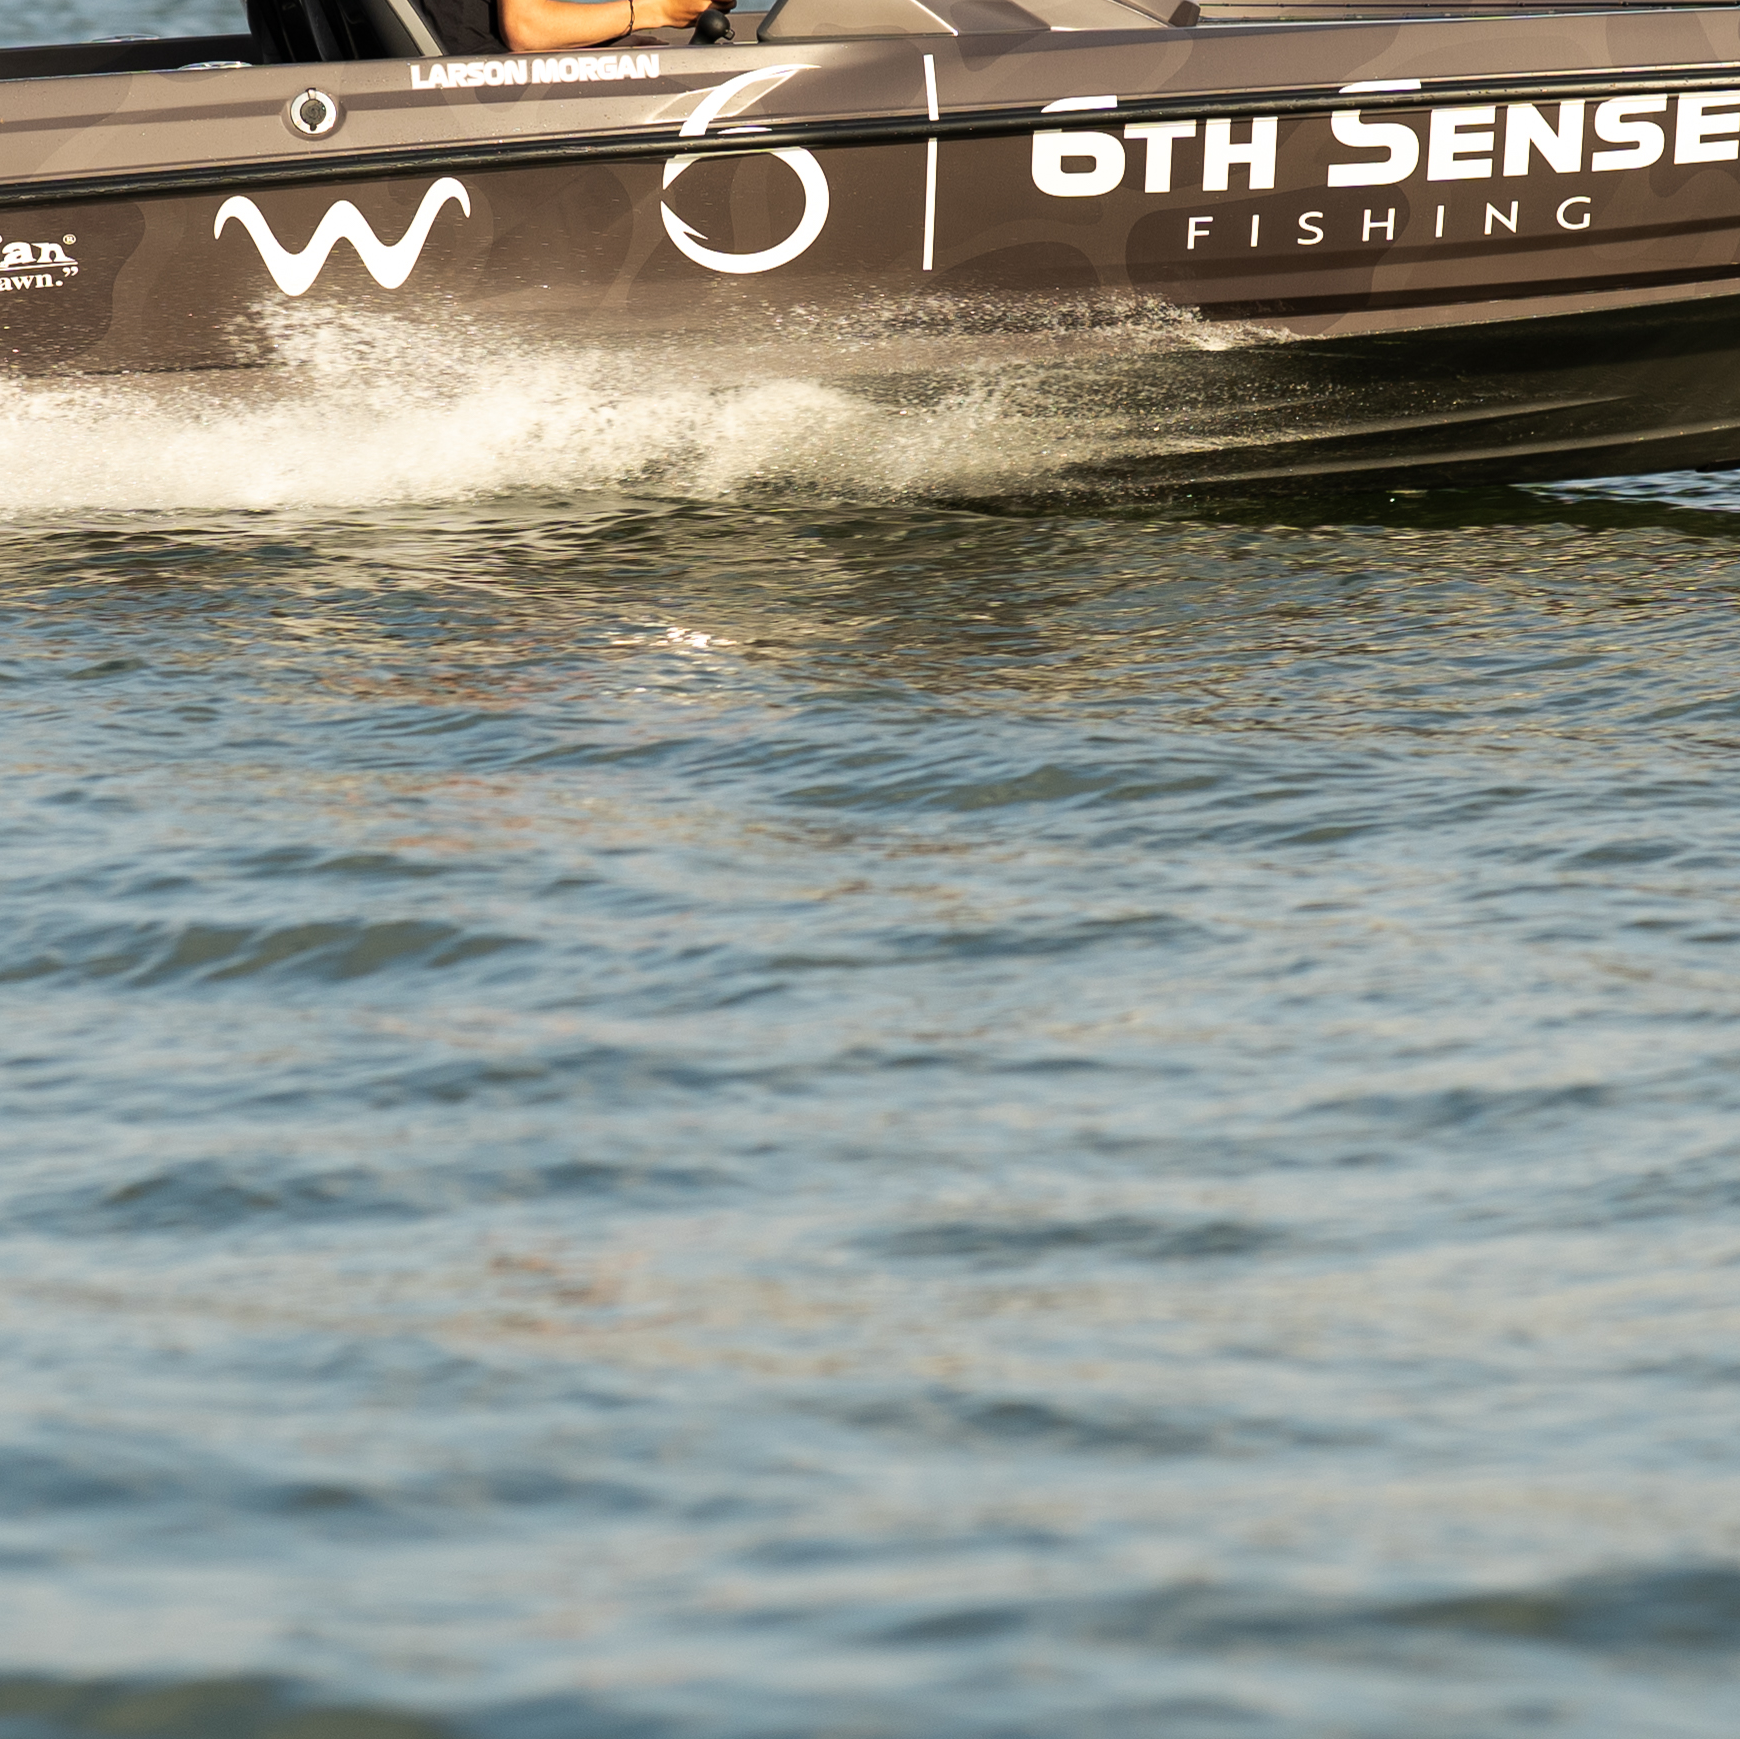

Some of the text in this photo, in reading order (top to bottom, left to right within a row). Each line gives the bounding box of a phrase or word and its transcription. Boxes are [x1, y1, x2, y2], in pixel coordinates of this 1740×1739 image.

[410, 53, 660, 90] LARSON MORGAN
[1031, 95, 1279, 198] 6TH
[1187, 196, 1592, 250] FISHING
